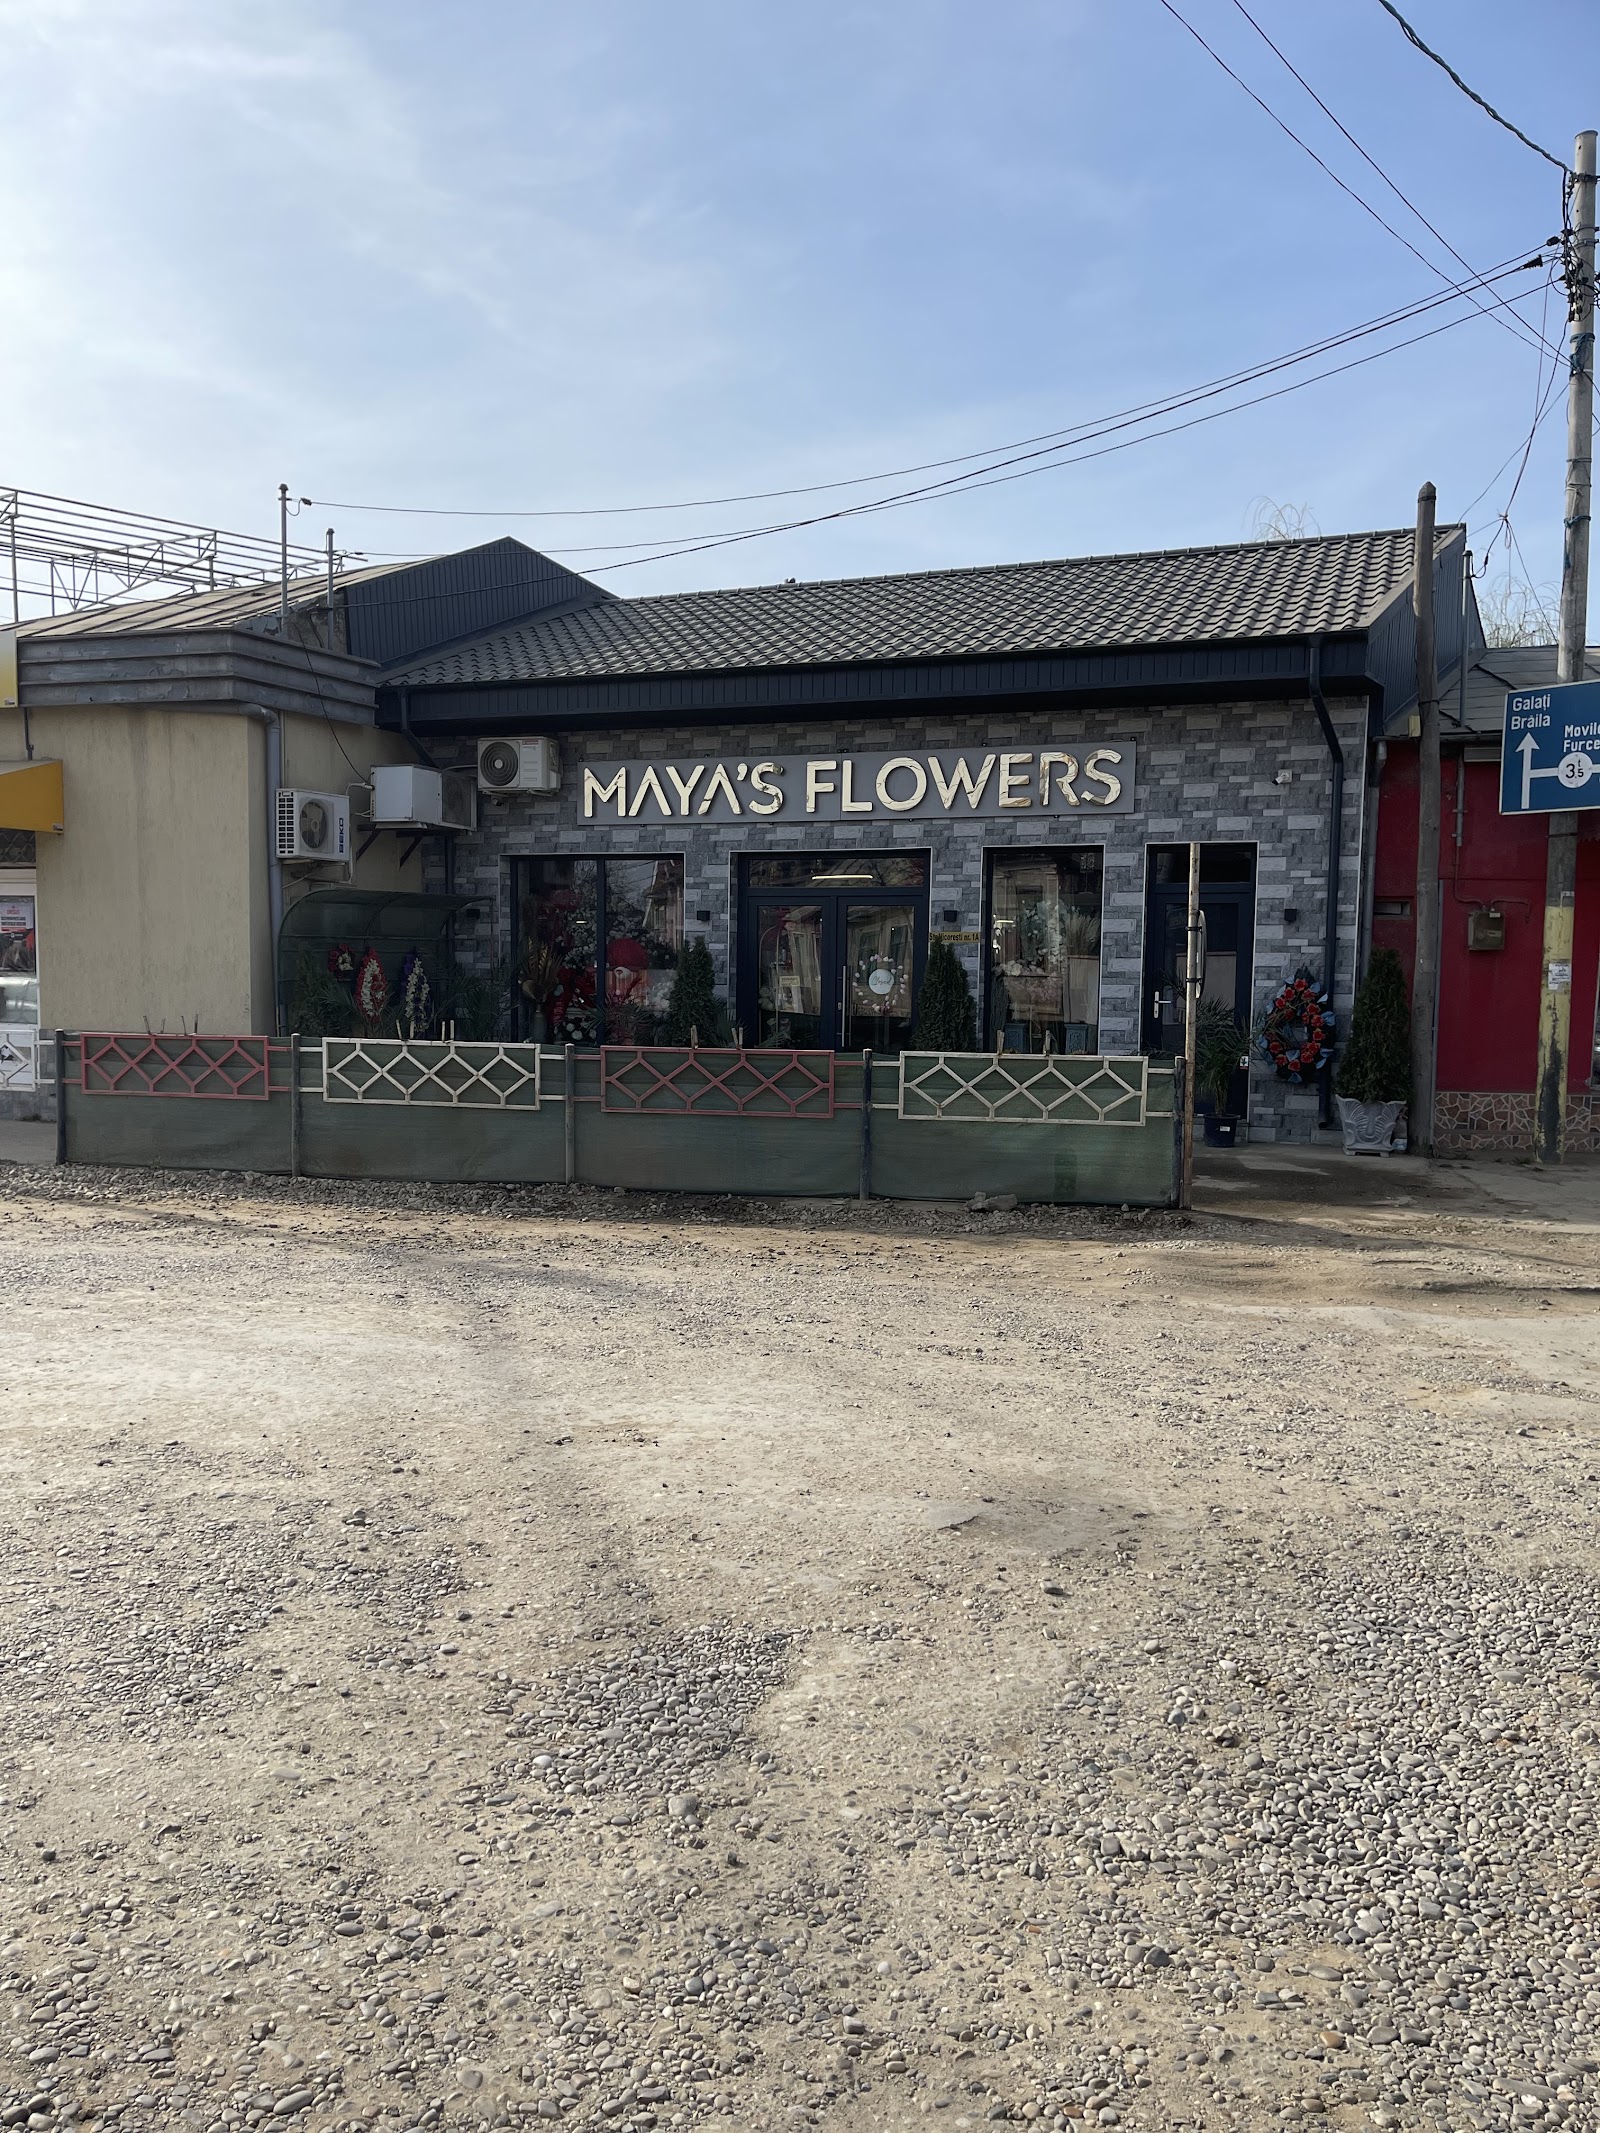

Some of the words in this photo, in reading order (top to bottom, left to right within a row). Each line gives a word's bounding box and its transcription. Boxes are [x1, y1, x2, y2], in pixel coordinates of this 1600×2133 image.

[1512, 694, 1551, 711] Galați
[1511, 713, 1551, 730] Brăila
[583, 761, 784, 818] MAYA'S
[805, 748, 1123, 813] FLOWERS
